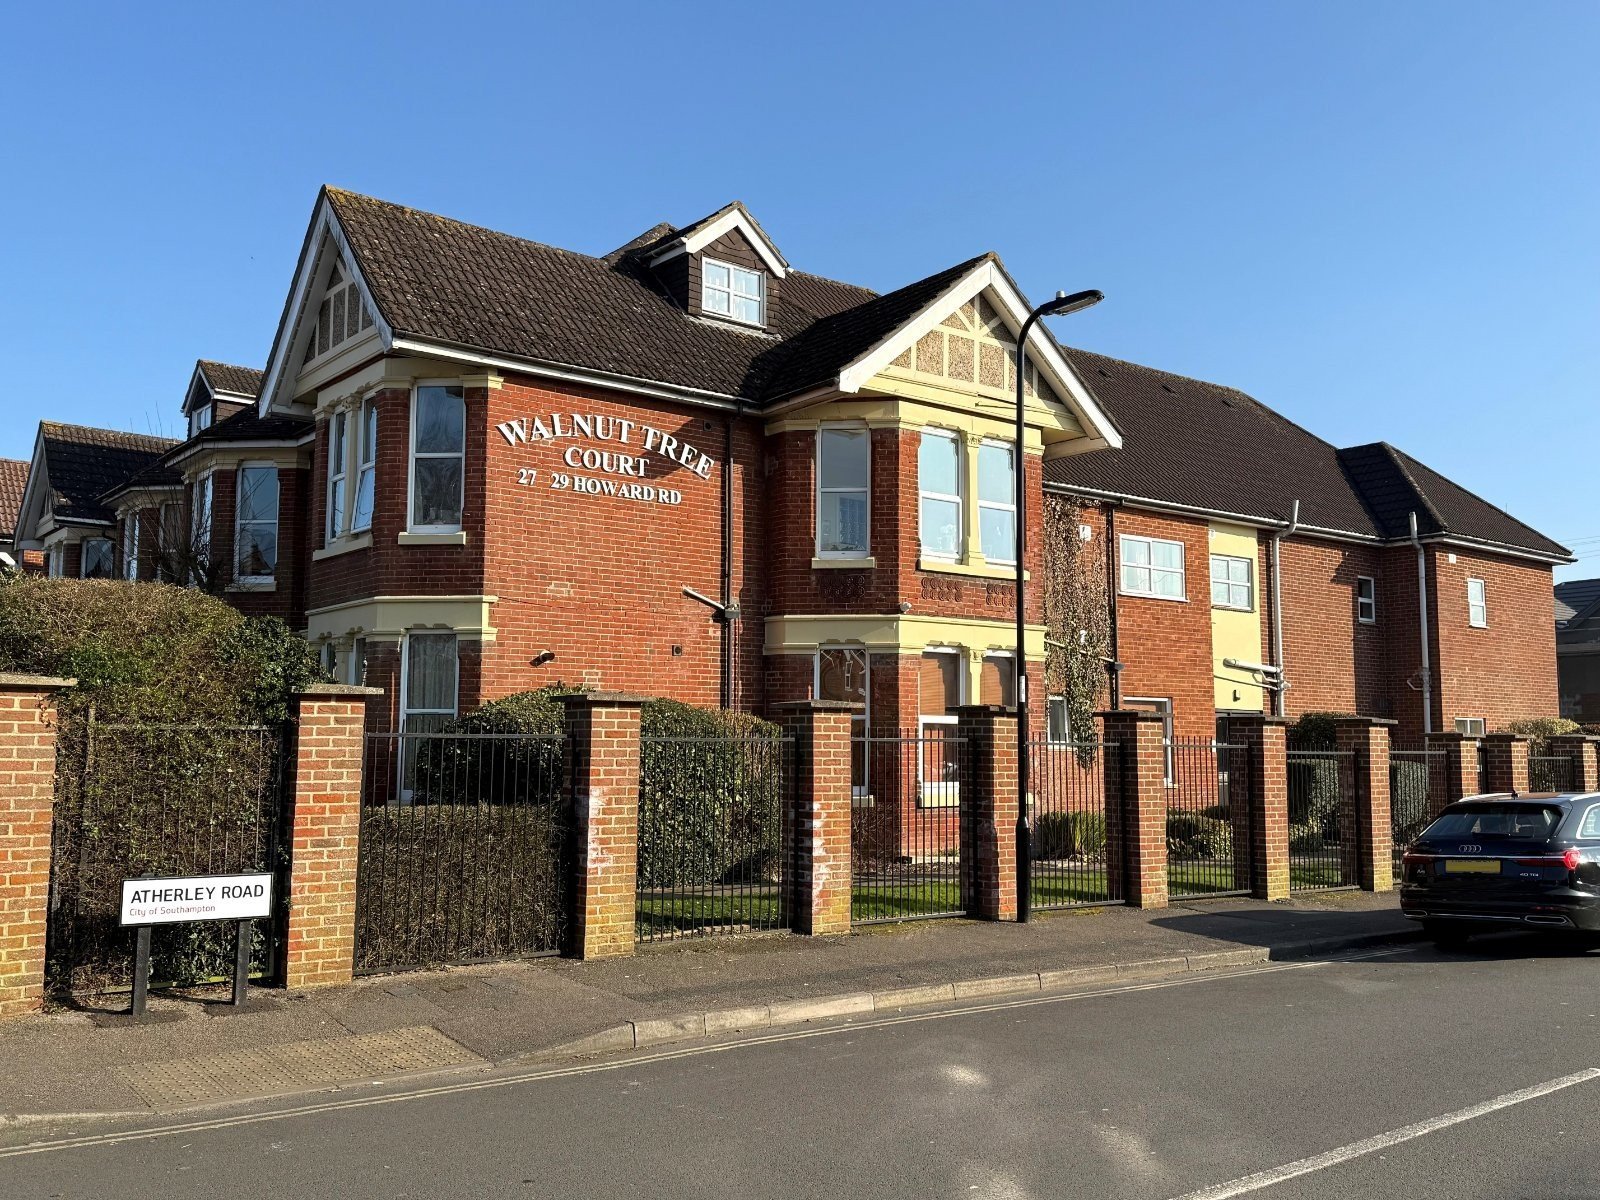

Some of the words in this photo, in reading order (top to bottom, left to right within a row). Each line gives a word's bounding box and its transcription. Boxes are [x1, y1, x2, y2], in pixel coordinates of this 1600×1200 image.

[496, 413, 635, 446] WALNUT
[641, 425, 715, 480] TREE
[564, 446, 649, 477] COURT
[517, 468, 537, 485] 27
[551, 472, 569, 489] 29
[573, 476, 654, 501] HOWARD
[658, 489, 682, 505] RD
[131, 887, 216, 903] ATHERLEY
[222, 885, 264, 899] ROAD
[129, 907, 146, 917] City
[148, 906, 157, 915] of
[160, 905, 216, 916] Southampton
